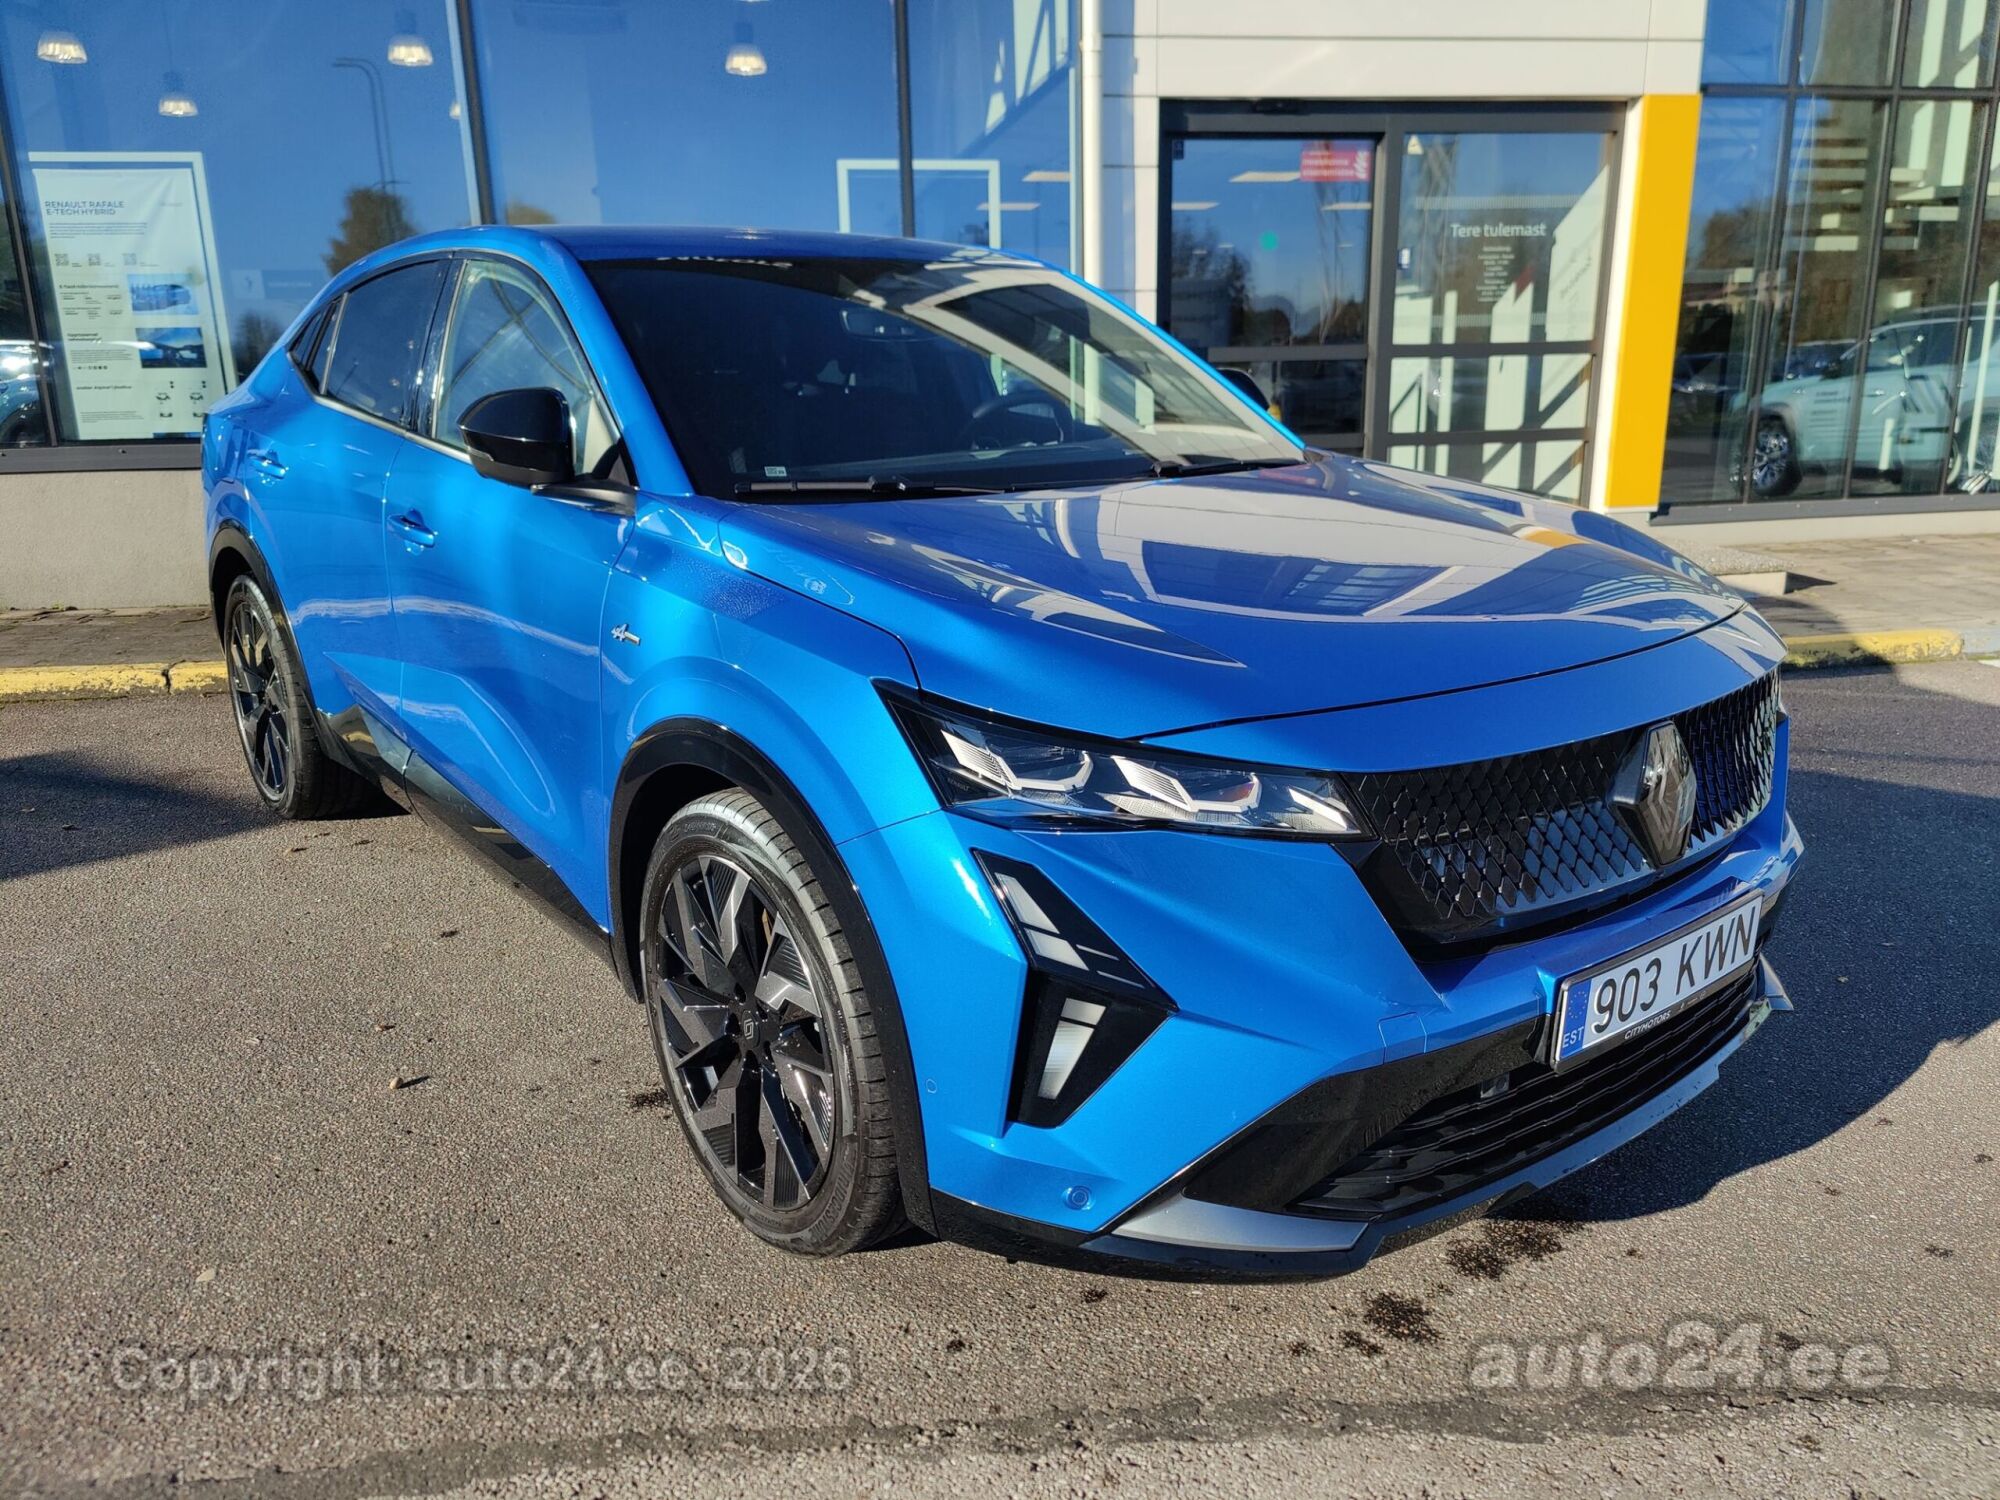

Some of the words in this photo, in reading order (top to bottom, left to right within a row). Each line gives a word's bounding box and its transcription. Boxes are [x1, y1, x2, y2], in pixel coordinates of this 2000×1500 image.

[45, 201, 87, 209] RENAULT
[89, 201, 125, 209] RAFALE
[1451, 224, 1480, 237] Tere
[1484, 222, 1547, 237] tulemast
[1591, 957, 1662, 1034] 903
[1675, 905, 1756, 996] KWN
[1624, 1009, 1671, 1041] CITYMOTORS
[1562, 1026, 1585, 1049] EST
